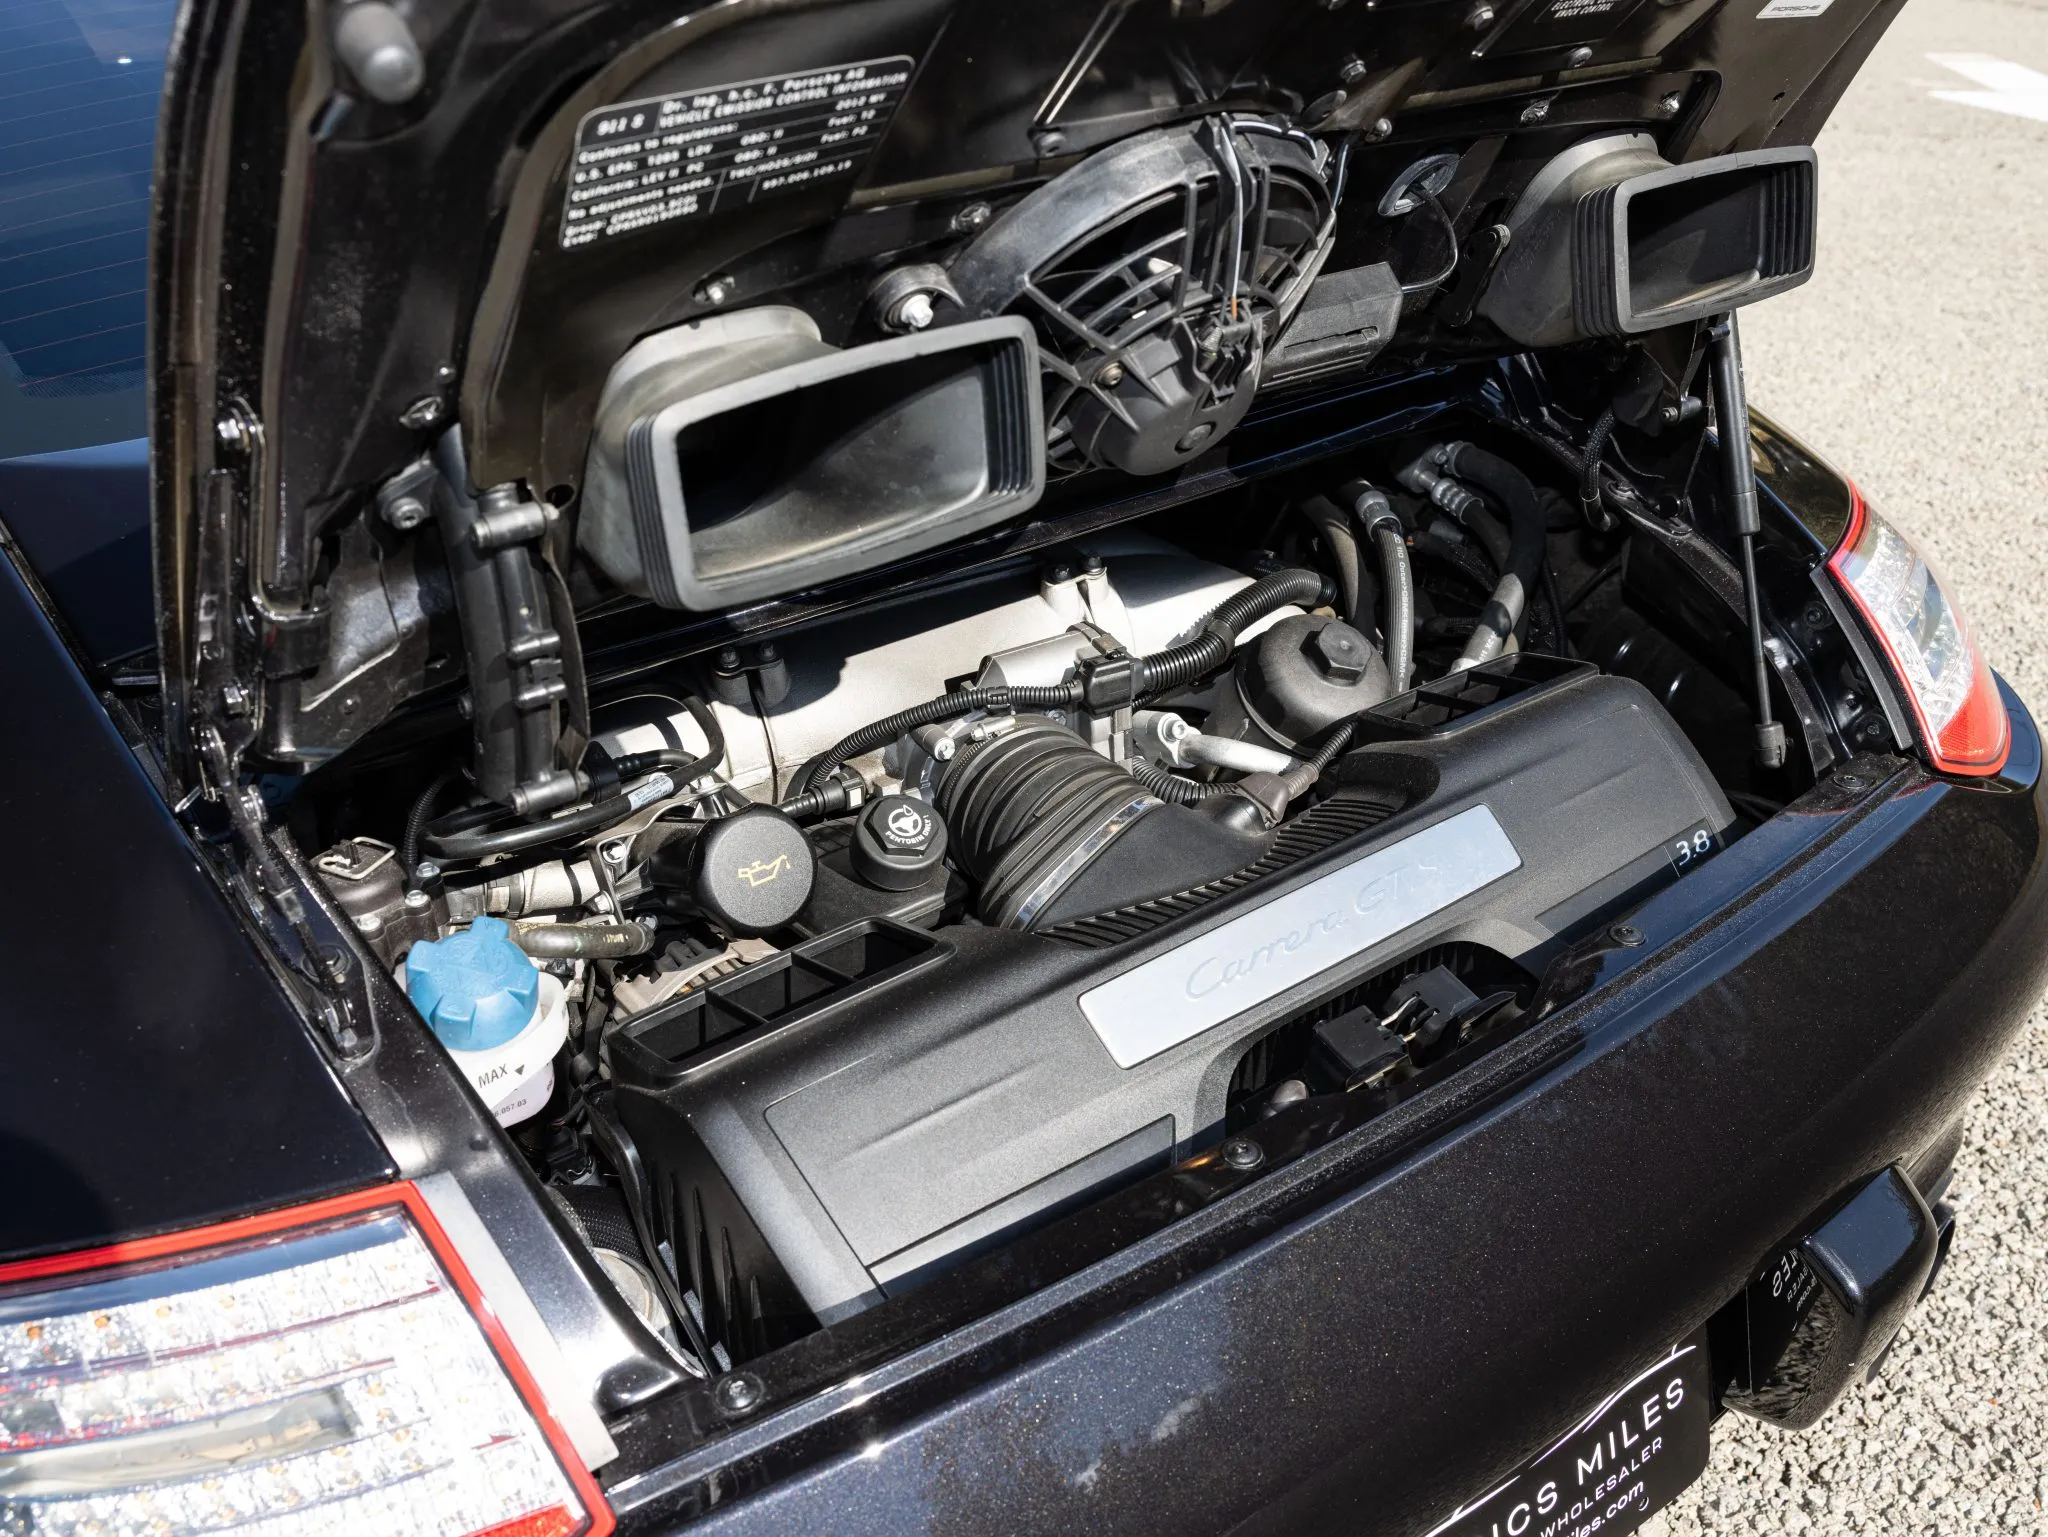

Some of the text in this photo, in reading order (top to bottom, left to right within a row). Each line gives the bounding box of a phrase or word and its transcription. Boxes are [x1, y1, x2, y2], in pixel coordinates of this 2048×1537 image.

[1553, 2, 1614, 18] KNOCK CONTROL
[775, 87, 828, 107] CONTROL
[832, 72, 908, 95] INFORMATION
[783, 72, 841, 92] Porsche
[845, 67, 866, 81] AG
[1676, 829, 1710, 866] 3.8
[1185, 910, 1349, 1000] Carrera
[478, 1063, 508, 1089] MAX
[1576, 1377, 1685, 1486] MILES
[1540, 1436, 1663, 1537] WHOLESALER
